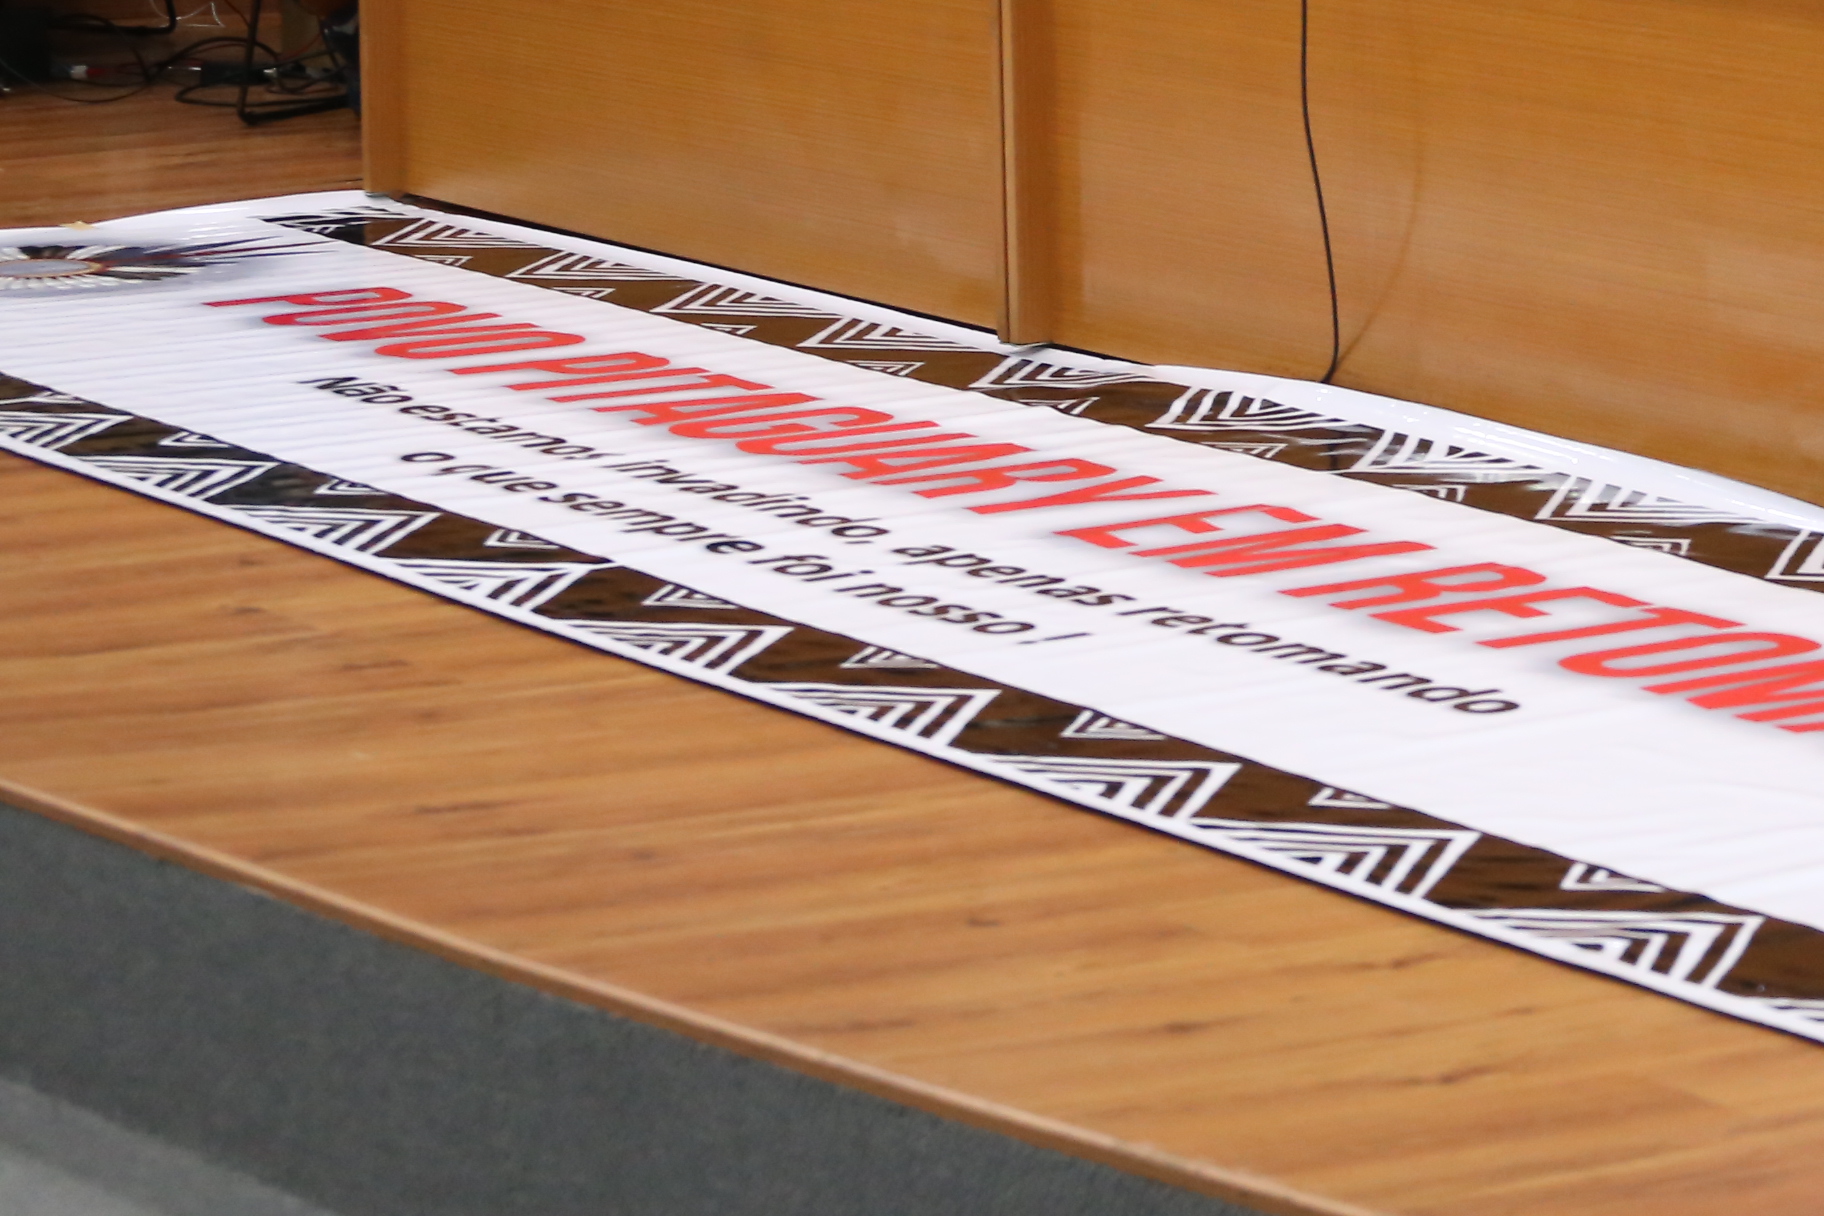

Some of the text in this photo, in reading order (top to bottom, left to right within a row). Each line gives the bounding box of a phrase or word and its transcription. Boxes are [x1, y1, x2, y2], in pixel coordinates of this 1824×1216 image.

[202, 286, 586, 360] POVO
[446, 351, 1218, 515] PITAGUARY
[1051, 503, 1437, 578] EM
[302, 375, 1521, 715] Não estamos invadindo, apenas retomando
[400, 451, 455, 465] o
[540, 490, 765, 558] sempre
[749, 543, 876, 583] foi
[833, 581, 1036, 637] nosso
